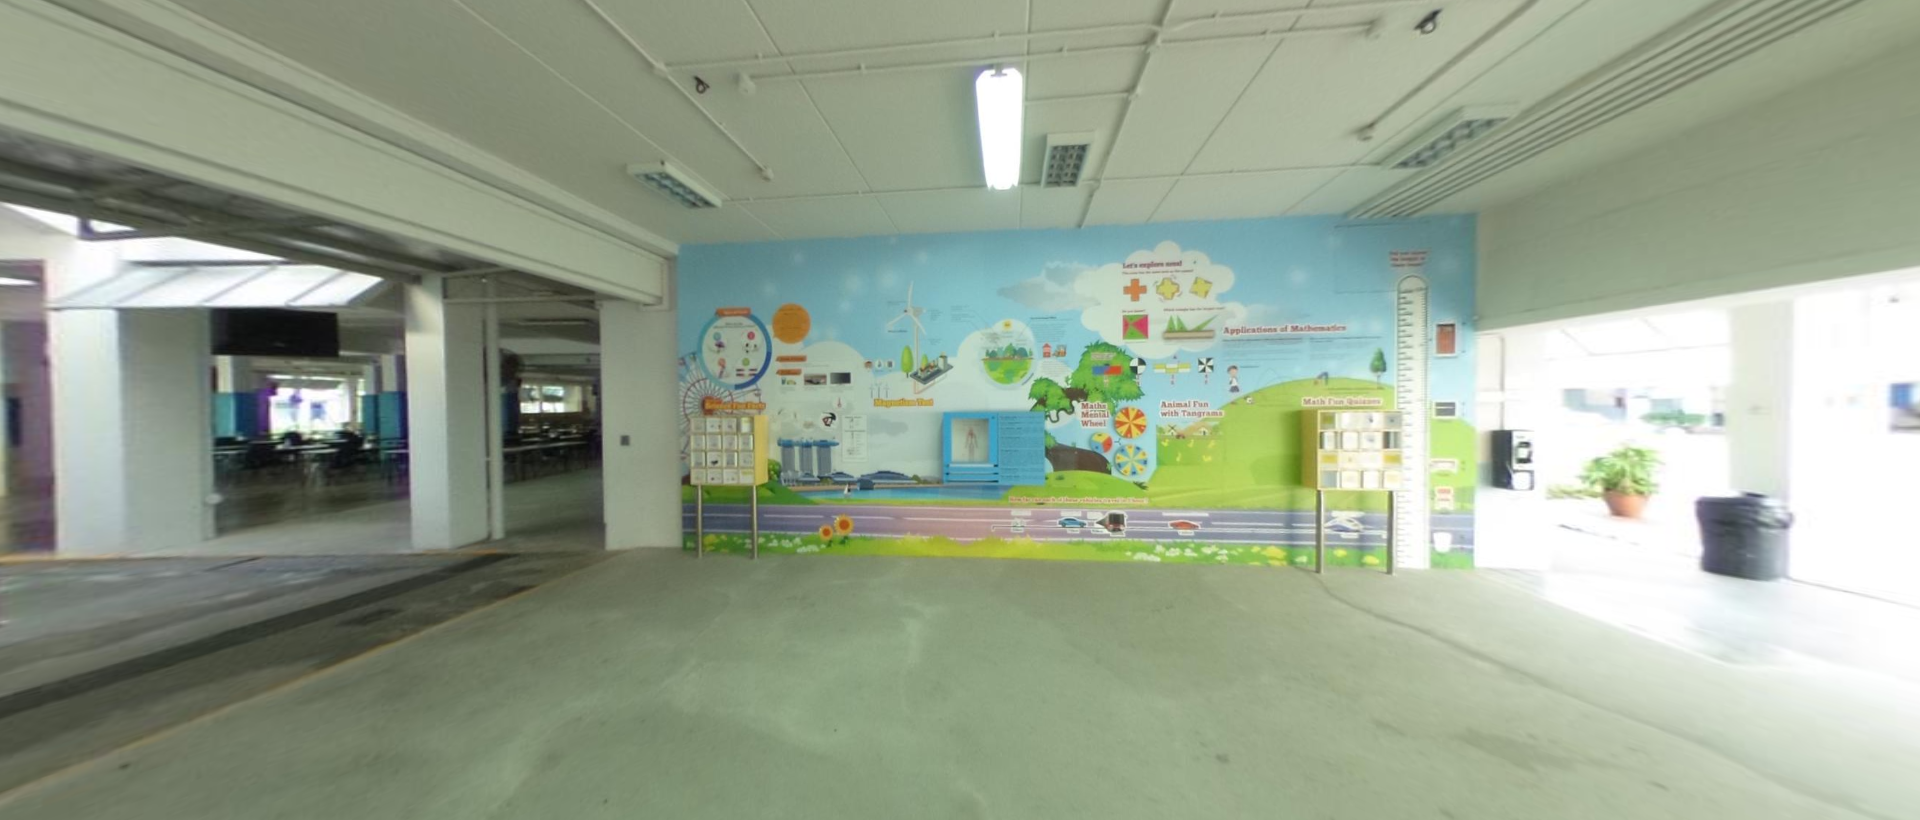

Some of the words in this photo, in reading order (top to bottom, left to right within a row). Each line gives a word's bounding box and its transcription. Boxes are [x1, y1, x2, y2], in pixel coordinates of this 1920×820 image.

[1139, 261, 1164, 270] explore
[1223, 326, 1278, 335] Applications
[1290, 324, 1347, 332] Mathematics
[1181, 410, 1223, 418] Tangrams
